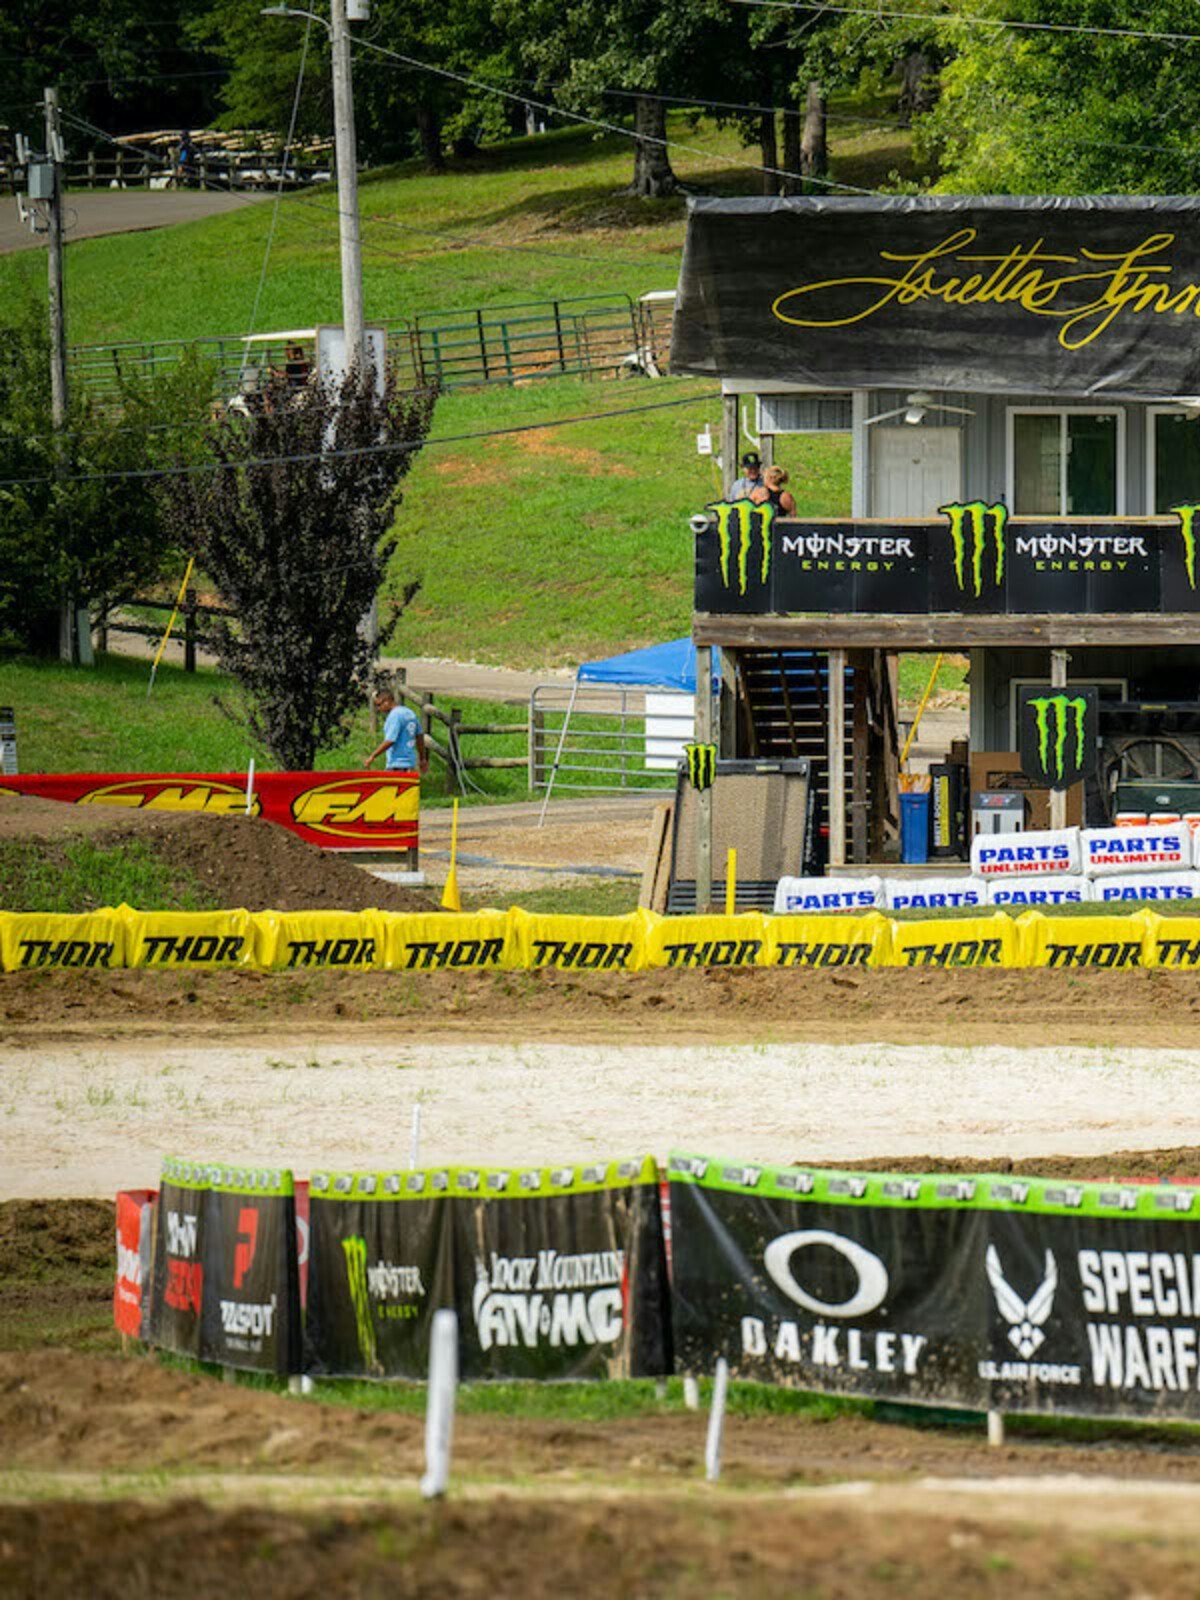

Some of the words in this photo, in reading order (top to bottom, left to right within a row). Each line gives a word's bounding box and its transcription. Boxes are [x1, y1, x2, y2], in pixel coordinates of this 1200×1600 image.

[772, 228, 1078, 328] Loretta
[782, 532, 915, 558] MONSTER
[1015, 532, 1148, 558] MONSTER
[801, 560, 894, 571] ENERGY
[1035, 560, 1128, 571] ENERGY
[979, 844, 1069, 863] PARTS
[1089, 836, 1181, 854] PARTS
[980, 861, 1070, 874] UNLIMITED
[1090, 852, 1181, 865] UNLIMITED
[786, 890, 875, 910] PARTS
[893, 891, 979, 910] PARTS
[993, 890, 1082, 905] PARTS
[1103, 885, 1193, 901] PARTS
[19, 940, 114, 967] THOR
[143, 936, 245, 963] THOR
[287, 938, 376, 967] THOR
[405, 937, 504, 968] THOR
[532, 940, 633, 969] THOR
[663, 939, 762, 967] THOR
[775, 943, 873, 967] THOR
[902, 938, 1002, 966] THOR
[1045, 942, 1142, 967] THOR
[741, 1316, 927, 1375] OAKLEY
